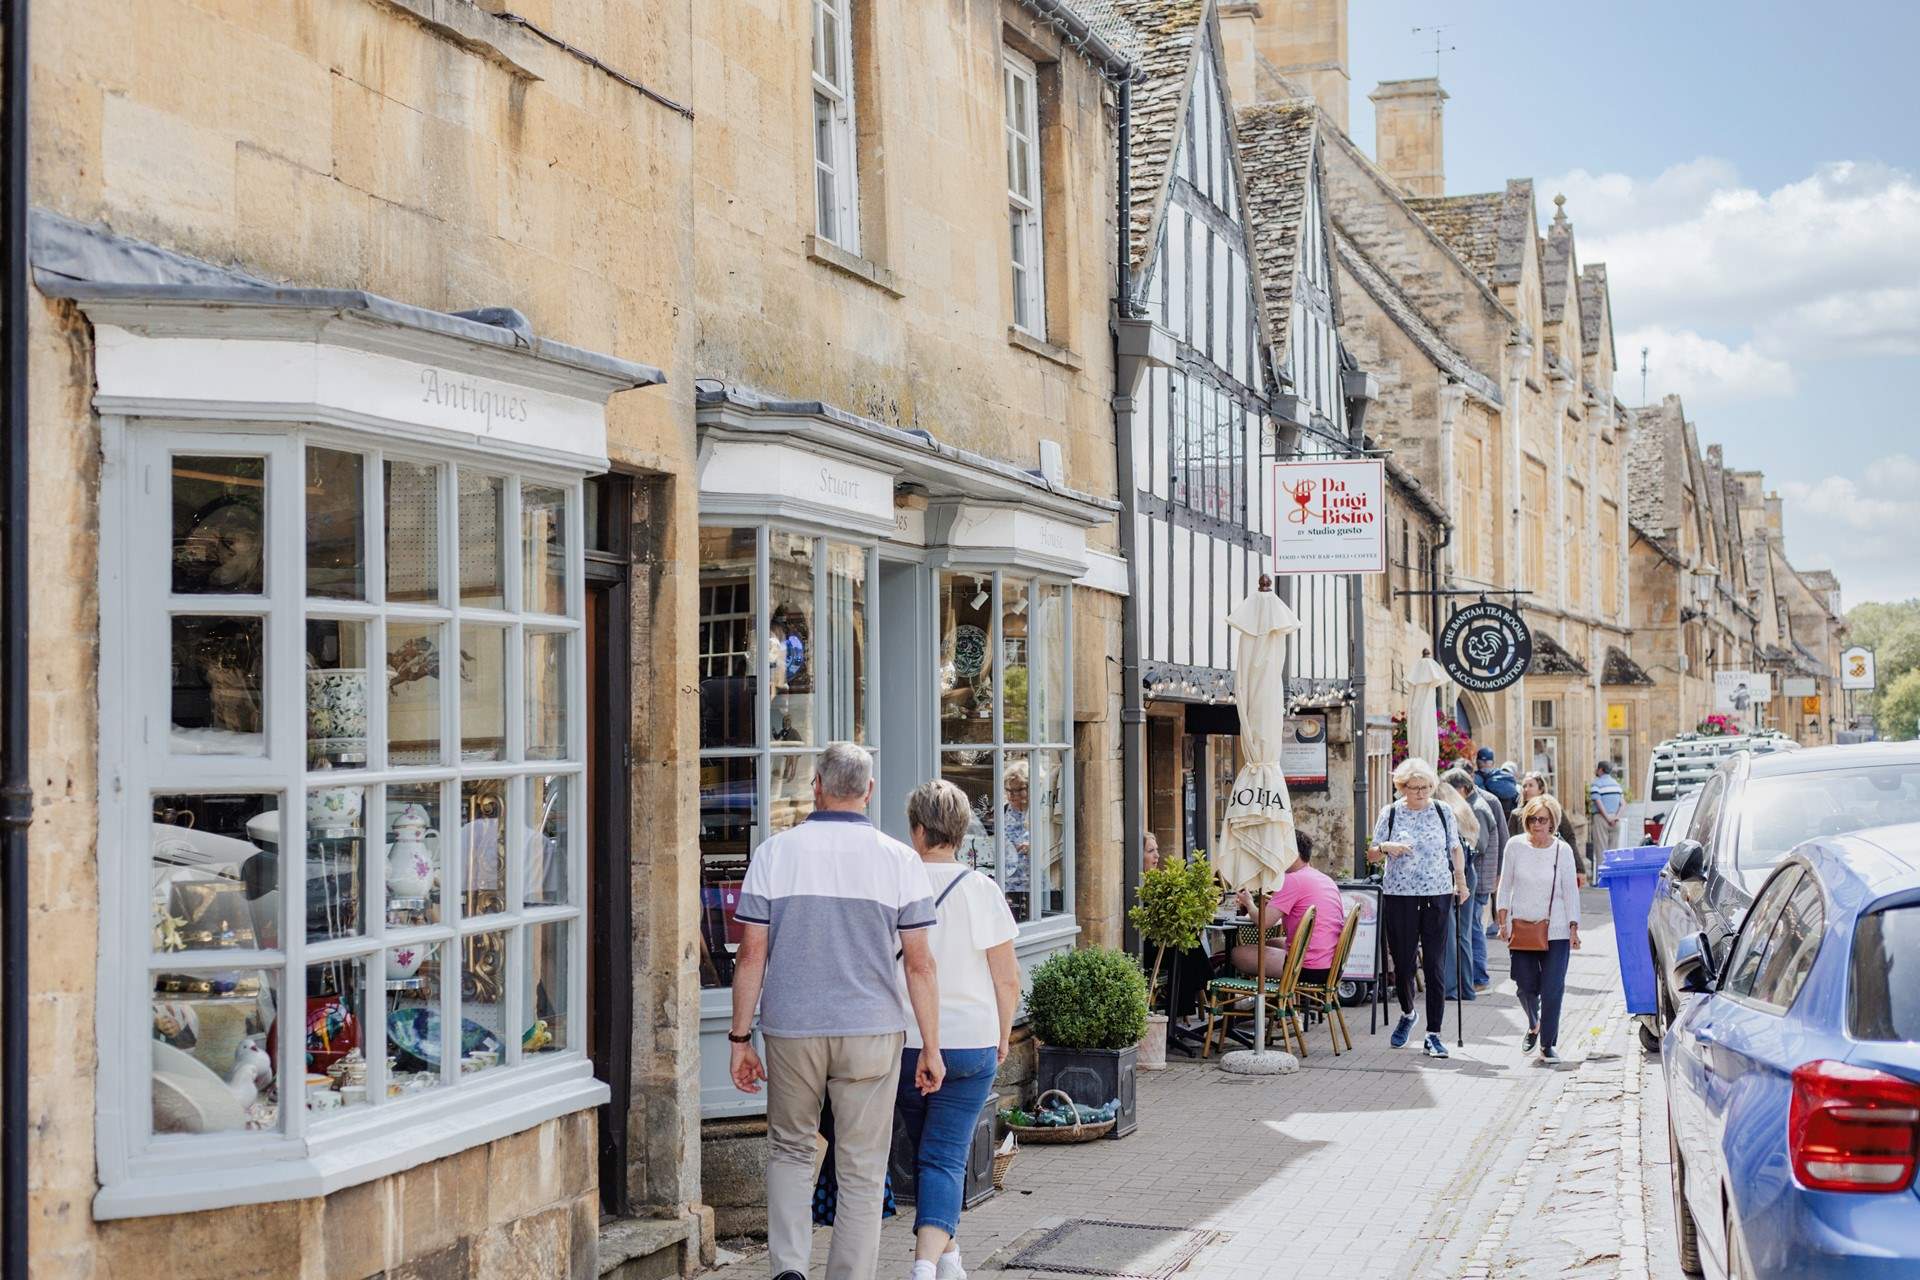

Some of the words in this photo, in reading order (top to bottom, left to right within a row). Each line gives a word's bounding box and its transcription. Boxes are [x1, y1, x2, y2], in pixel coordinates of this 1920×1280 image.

[421, 369, 528, 433] Antiques
[820, 467, 860, 499] Stuart
[1322, 478, 1345, 492] Da
[1322, 493, 1367, 511] Luigi
[1322, 509, 1374, 525] Bistro
[1308, 526, 1336, 536] studio
[1337, 527, 1363, 536] gusto
[1444, 630, 1454, 648] THE
[1452, 606, 1485, 631] BANTAM
[1486, 606, 1502, 617] TEA
[1502, 613, 1526, 642] ROOMS
[1449, 663, 1457, 672] &
[1455, 657, 1525, 689] ACCOMMODATION
